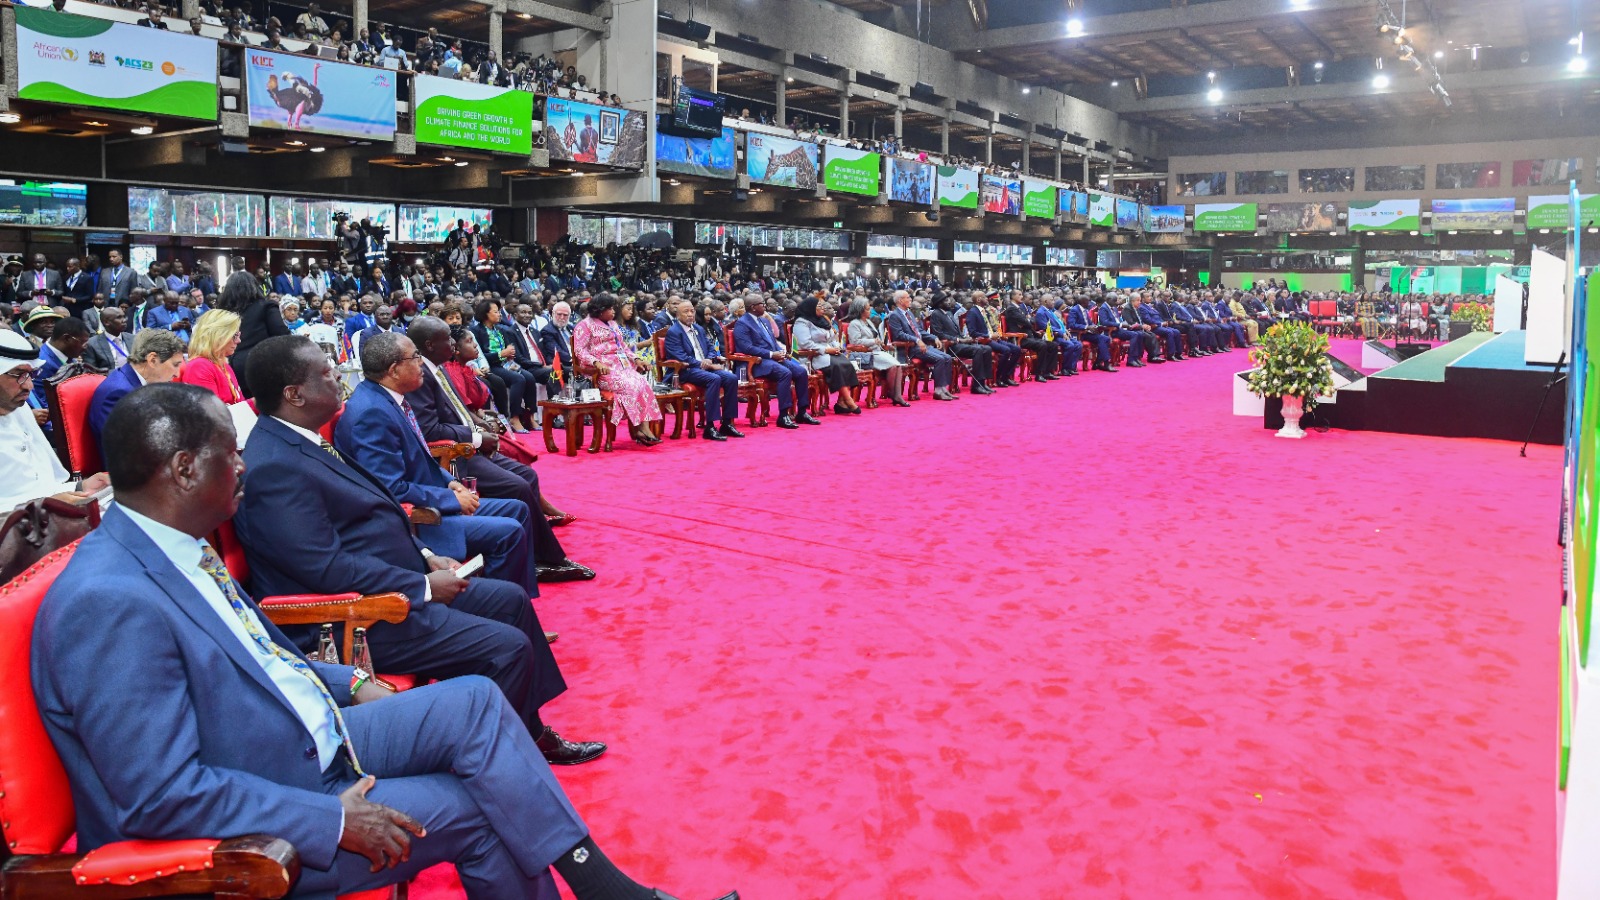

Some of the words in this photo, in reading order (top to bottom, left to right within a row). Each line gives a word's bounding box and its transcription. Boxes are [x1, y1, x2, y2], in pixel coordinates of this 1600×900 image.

[33, 41, 60, 52] African
[37, 50, 62, 60] Union
[125, 58, 153, 70] ACS23
[437, 107, 460, 118] DRIVING
[462, 110, 482, 120] GREEN
[483, 113, 508, 124] GROWTH
[425, 116, 451, 127] CLIMATE
[453, 120, 477, 130] FINANCE
[480, 123, 510, 135] SOLUTIONS
[512, 128, 523, 136] FOR
[440, 129, 461, 139] AFRICA
[463, 132, 475, 140] AND
[477, 134, 488, 142] THE
[490, 136, 511, 145] WORLD
